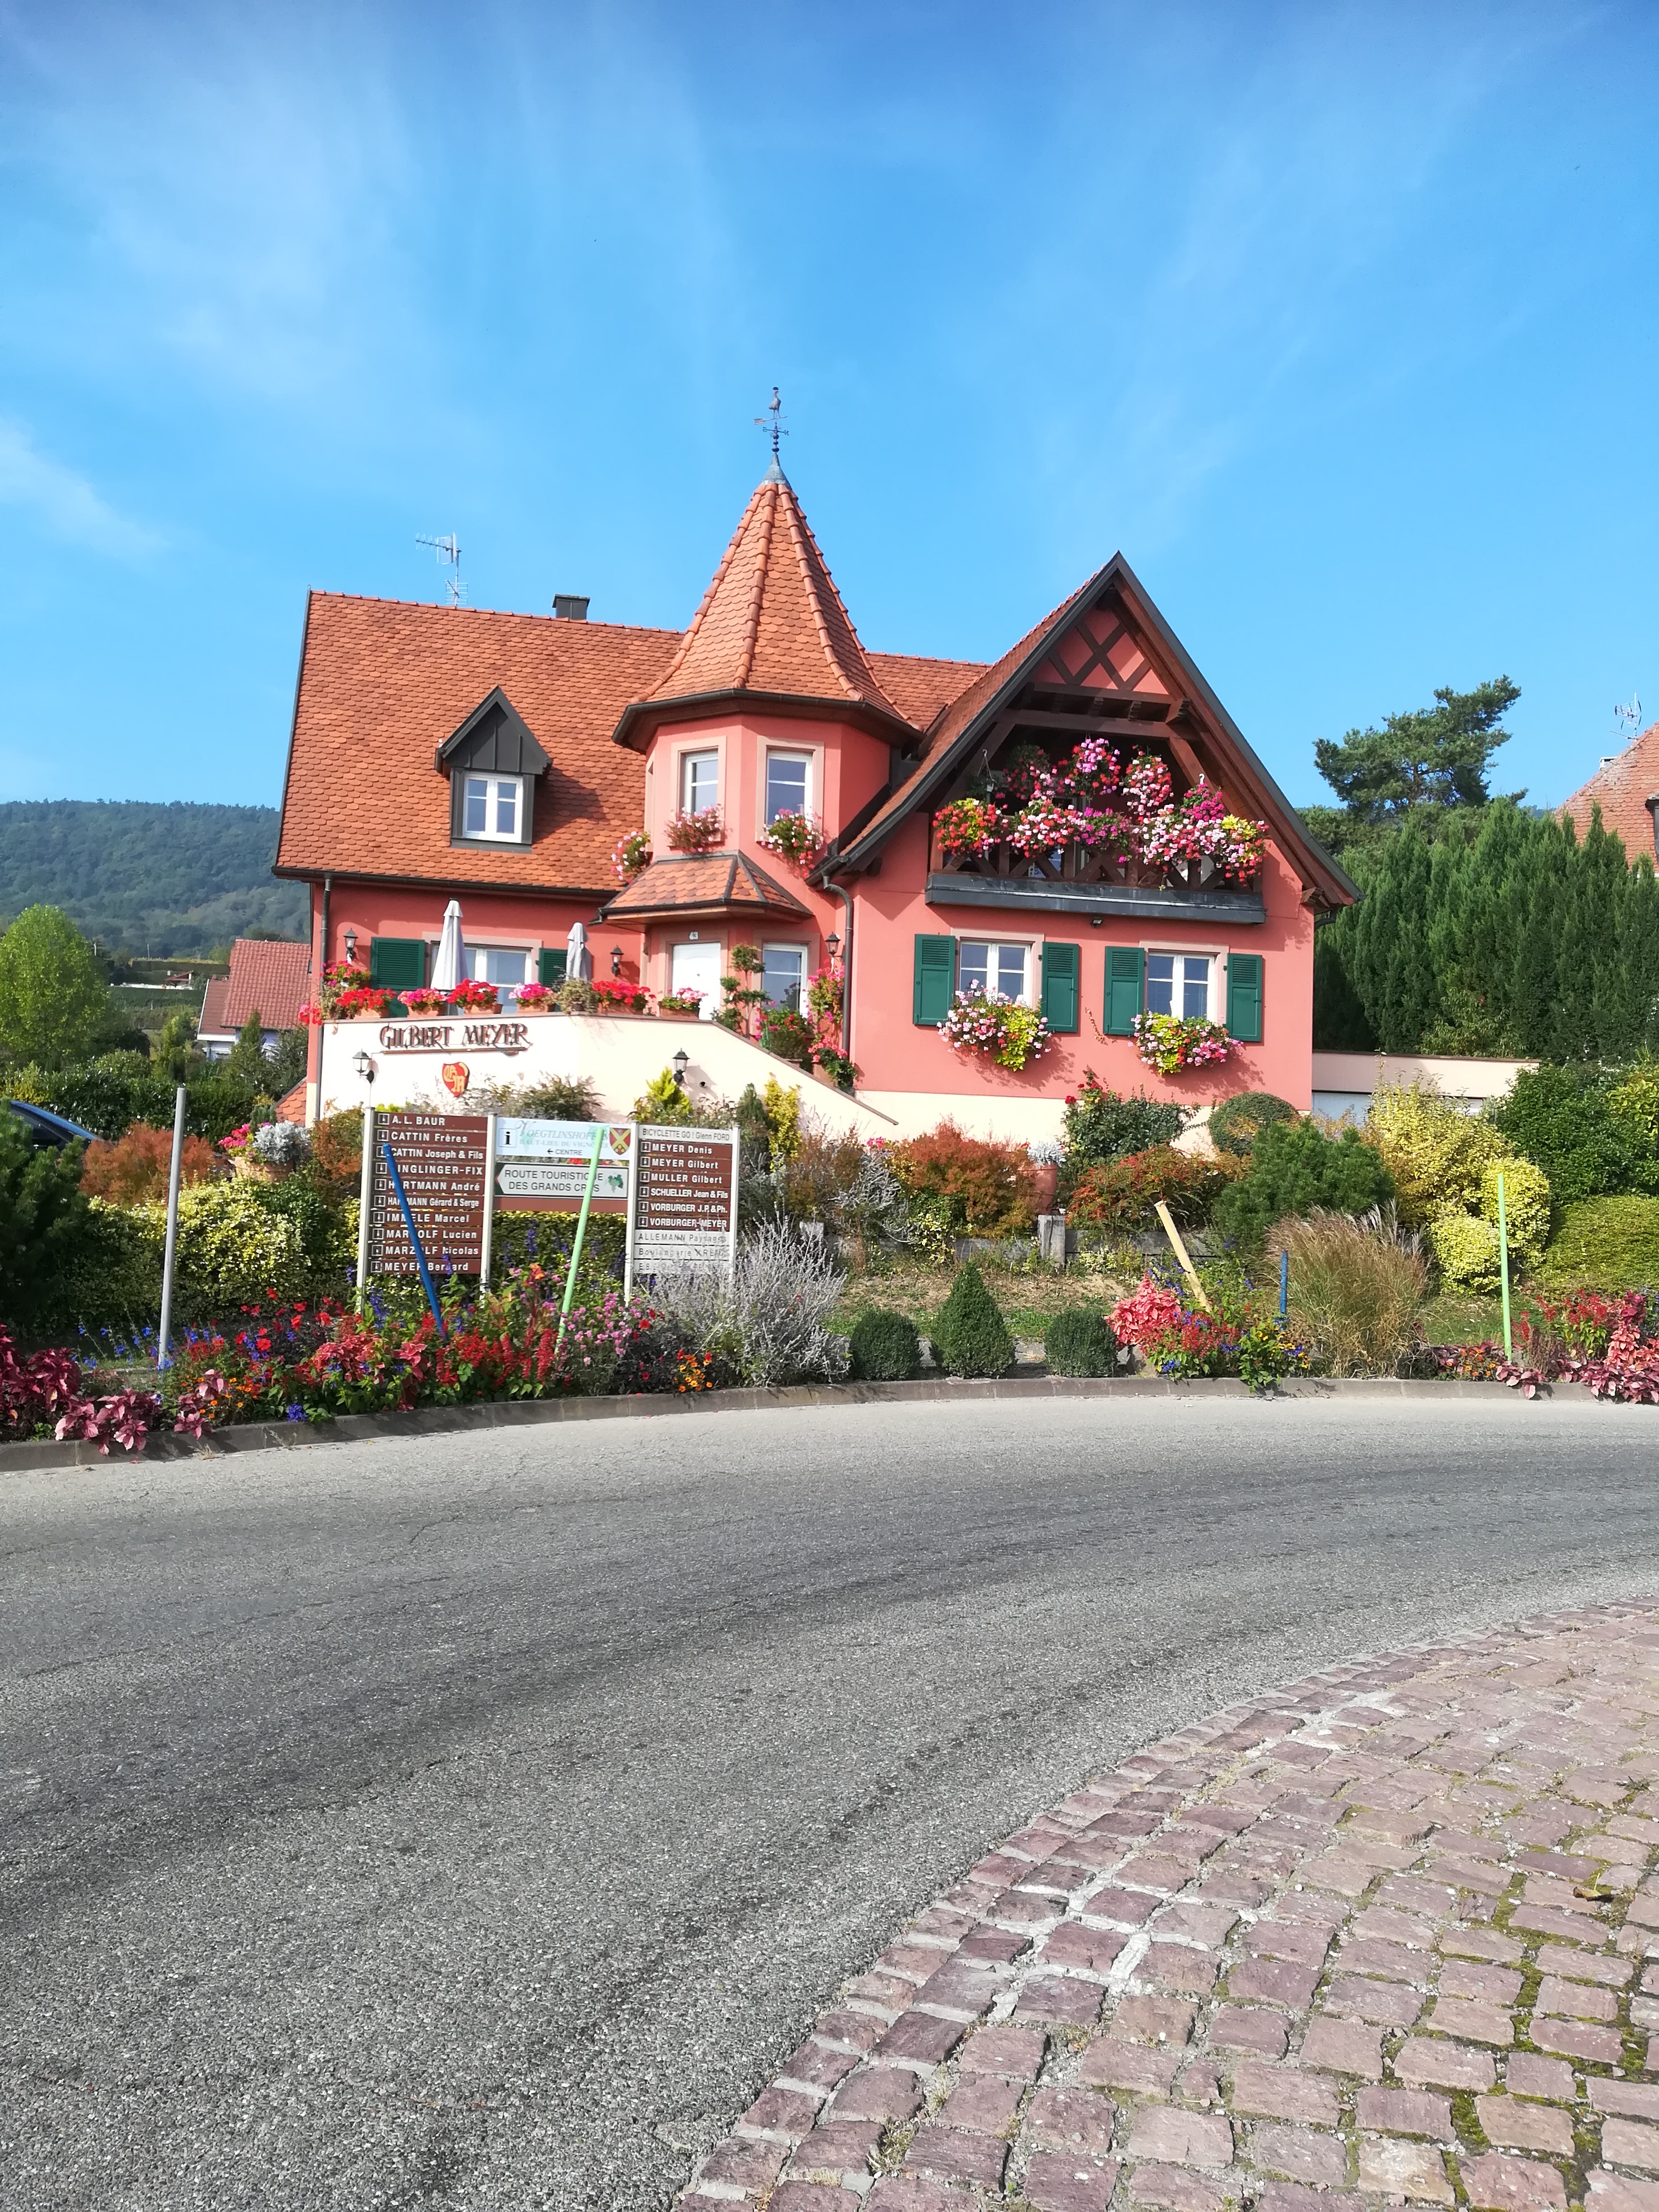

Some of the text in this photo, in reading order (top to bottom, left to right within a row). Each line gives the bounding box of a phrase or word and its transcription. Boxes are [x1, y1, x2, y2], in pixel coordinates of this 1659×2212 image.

[380, 1023, 533, 1052] GILBERT MEYER
[416, 1117, 445, 1126] BAUR
[391, 1132, 468, 1143] CATTIN Frères
[643, 1128, 680, 1138] BICYCLETTE
[652, 1143, 712, 1154] MEYER Denis
[391, 1148, 483, 1160] CATTIN Joseph & Fils
[651, 1158, 719, 1169] MEYER Gilbert
[395, 1165, 483, 1175] INGLINGER-FIX
[505, 1170, 538, 1178] ROUTE
[651, 1173, 722, 1183] MULLER Gilbert
[388, 1181, 480, 1191] HRTMANN André
[531, 1182, 571, 1191] GRANDS
[574, 1183, 600, 1192] CRS
[651, 1188, 692, 1197] SCHUELLER
[429, 1197, 452, 1206] Gérard
[459, 1199, 479, 1209] Serge
[650, 1203, 696, 1212] VORBURGER
[435, 1214, 469, 1223] Marcel
[650, 1218, 727, 1228] VORBURGER-MEYER
[386, 1230, 477, 1239] MAROLF Lucien
[385, 1246, 438, 1255] MARZLF
[428, 1263, 469, 1271] Berard
